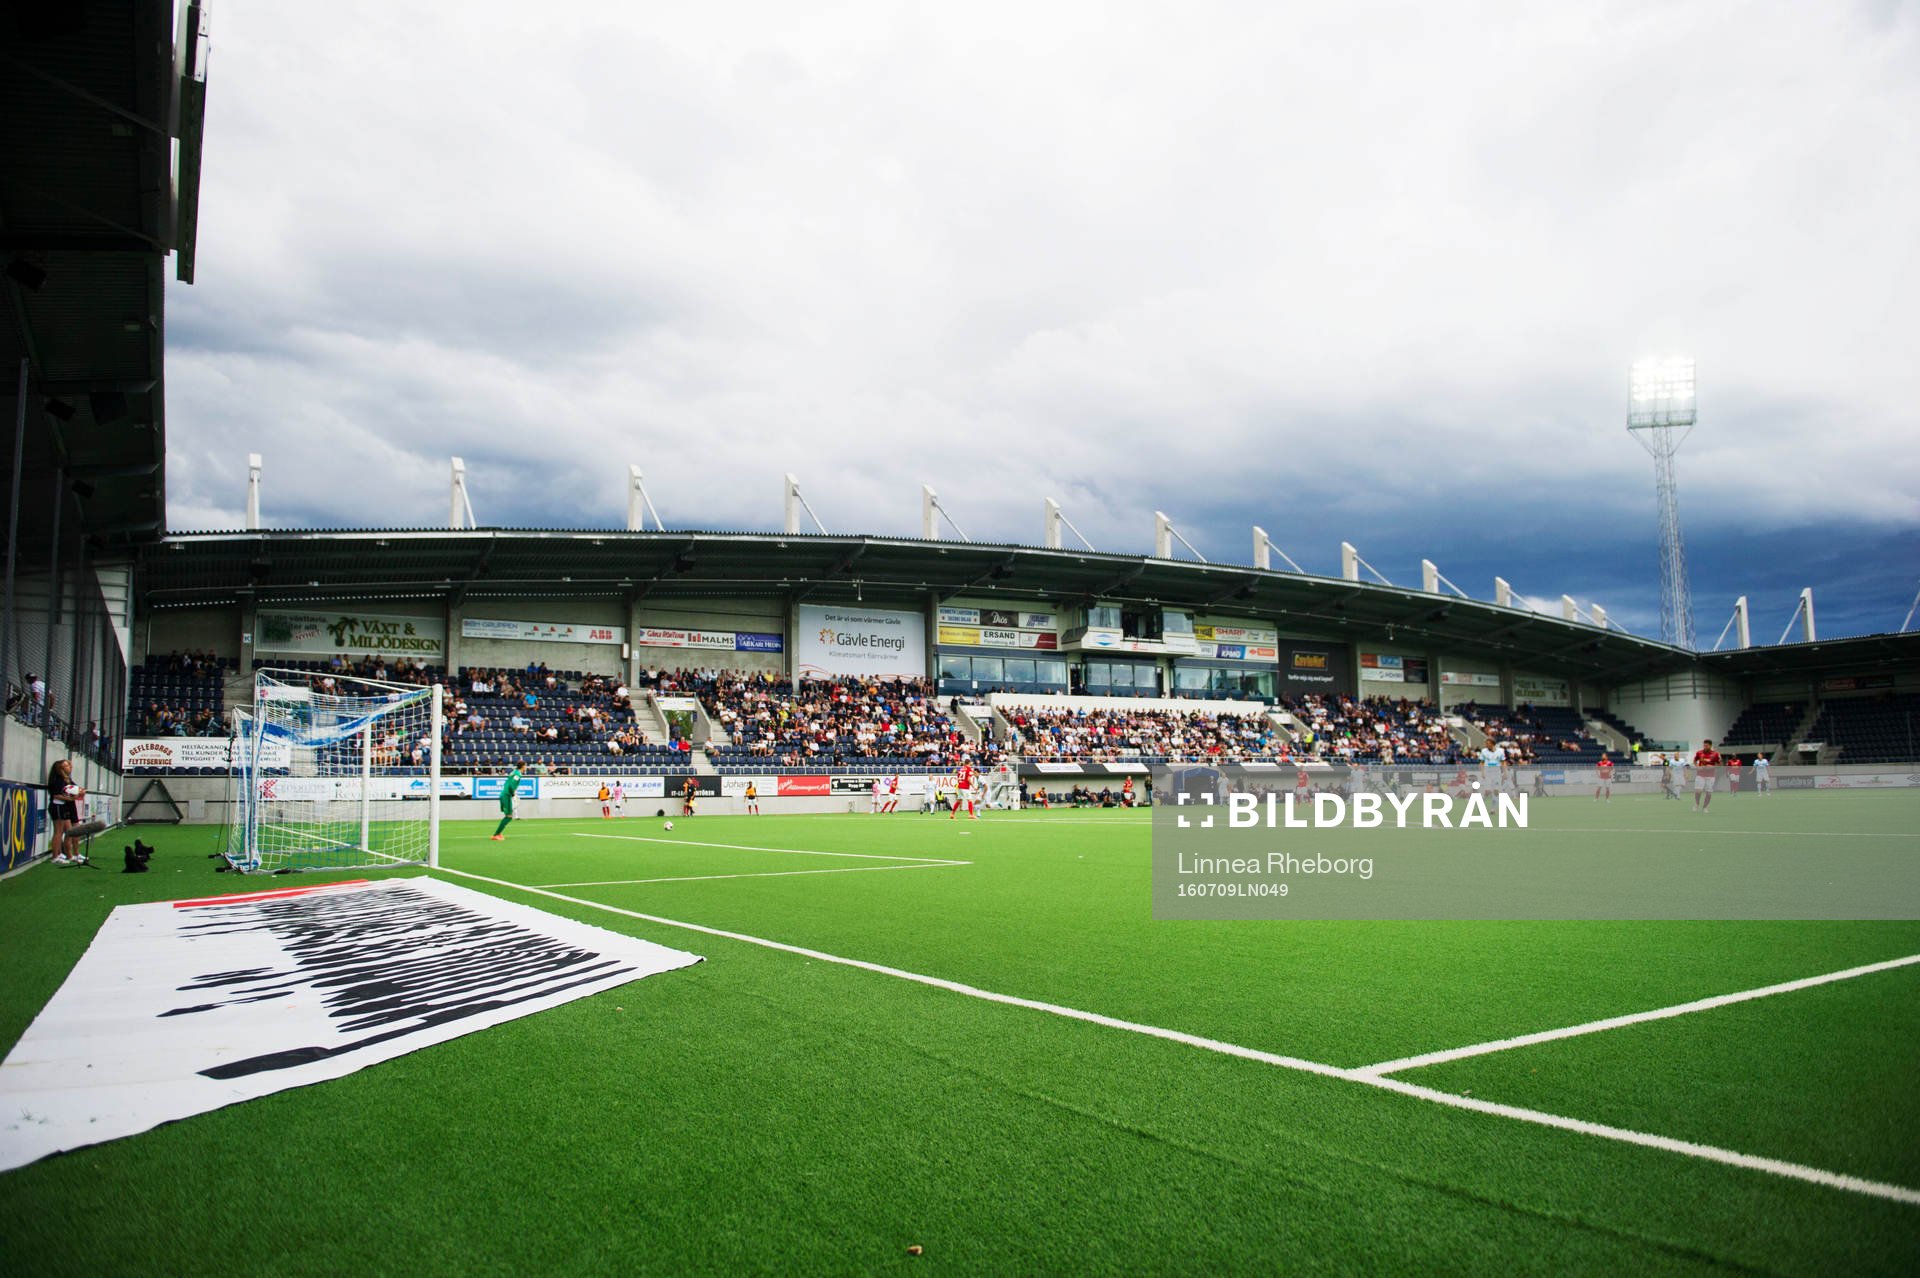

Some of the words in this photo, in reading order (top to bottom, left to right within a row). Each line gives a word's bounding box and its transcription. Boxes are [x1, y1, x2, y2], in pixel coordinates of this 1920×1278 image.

[864, 617, 885, 625] värmer
[361, 619, 400, 635] VÄXT
[404, 622, 416, 636] &
[1216, 628, 1246, 636] SHARP
[589, 629, 612, 640] ABB
[984, 631, 1015, 639] ERSAND
[349, 632, 442, 651] MILJÖDESIGN
[702, 636, 734, 645] MALMS
[837, 632, 868, 647] Gävle
[870, 634, 905, 652] Energi
[1221, 650, 1241, 658] KPMG
[128, 743, 173, 757] GEFLEBORGS
[128, 758, 173, 766] FLYTTSERVICE
